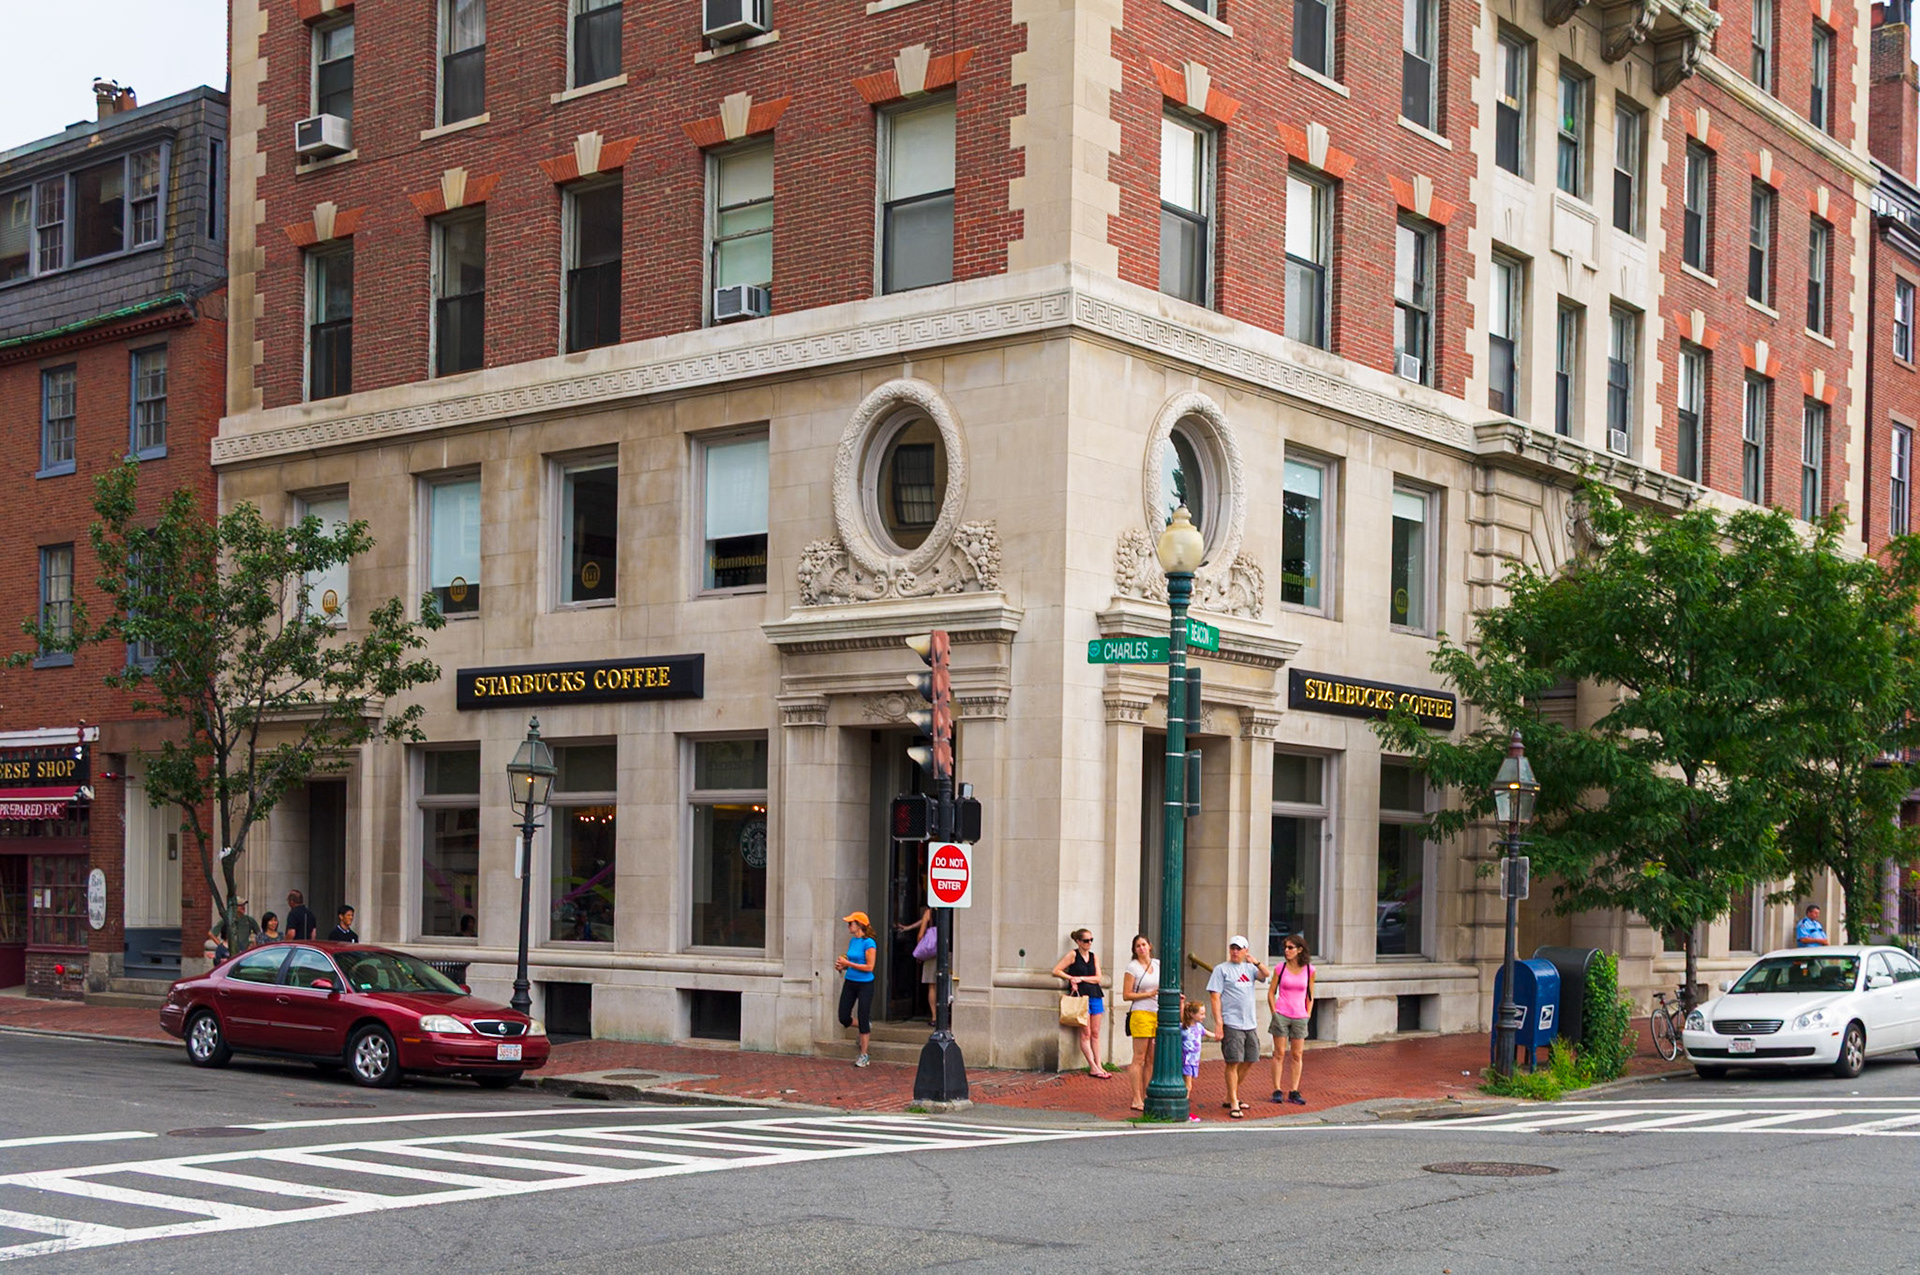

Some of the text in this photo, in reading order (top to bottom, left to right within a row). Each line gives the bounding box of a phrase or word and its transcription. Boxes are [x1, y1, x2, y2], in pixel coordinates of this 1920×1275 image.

[1190, 622, 1210, 645] BEACON
[1103, 641, 1159, 660] CHARLES ST
[474, 666, 671, 697] STARBUCKS COFFEE
[1304, 678, 1454, 719] STARBUCKS COFFEE
[37, 760, 76, 778] SHOP
[935, 857, 964, 868] DO NOT
[937, 880, 961, 891] ENTER
